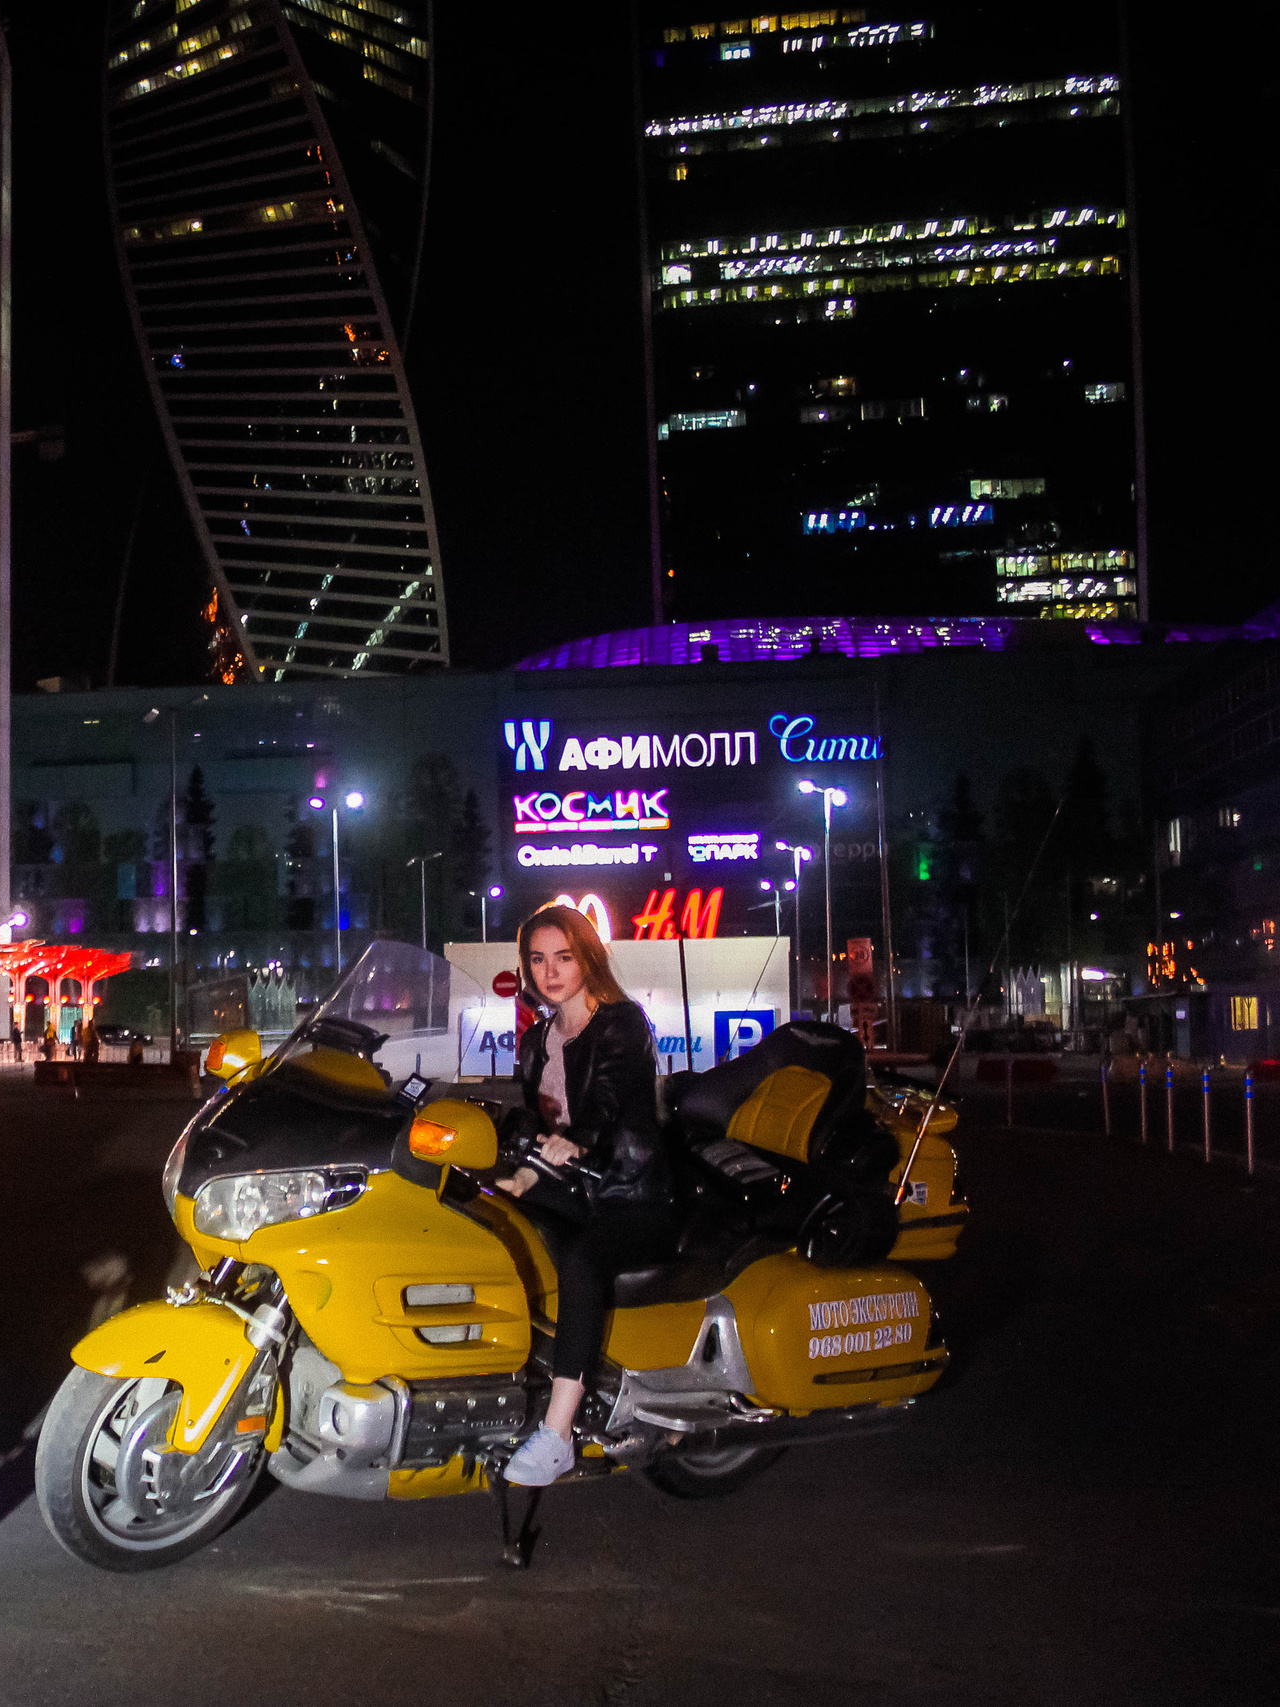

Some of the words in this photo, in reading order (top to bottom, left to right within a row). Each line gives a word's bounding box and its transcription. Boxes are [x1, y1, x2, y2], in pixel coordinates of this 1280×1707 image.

[559, 731, 756, 771] АФИМОЛЛ
[513, 787, 669, 821] КОСМИК
[631, 887, 724, 941] H&M
[729, 1018, 762, 1061] P
[808, 1300, 848, 1330] МОТО
[849, 1291, 919, 1324] ЭКСКУРСИИ
[809, 1335, 842, 1359] 968
[844, 1330, 871, 1354] 001
[874, 1325, 892, 1350] 22
[894, 1322, 912, 1344] 80
